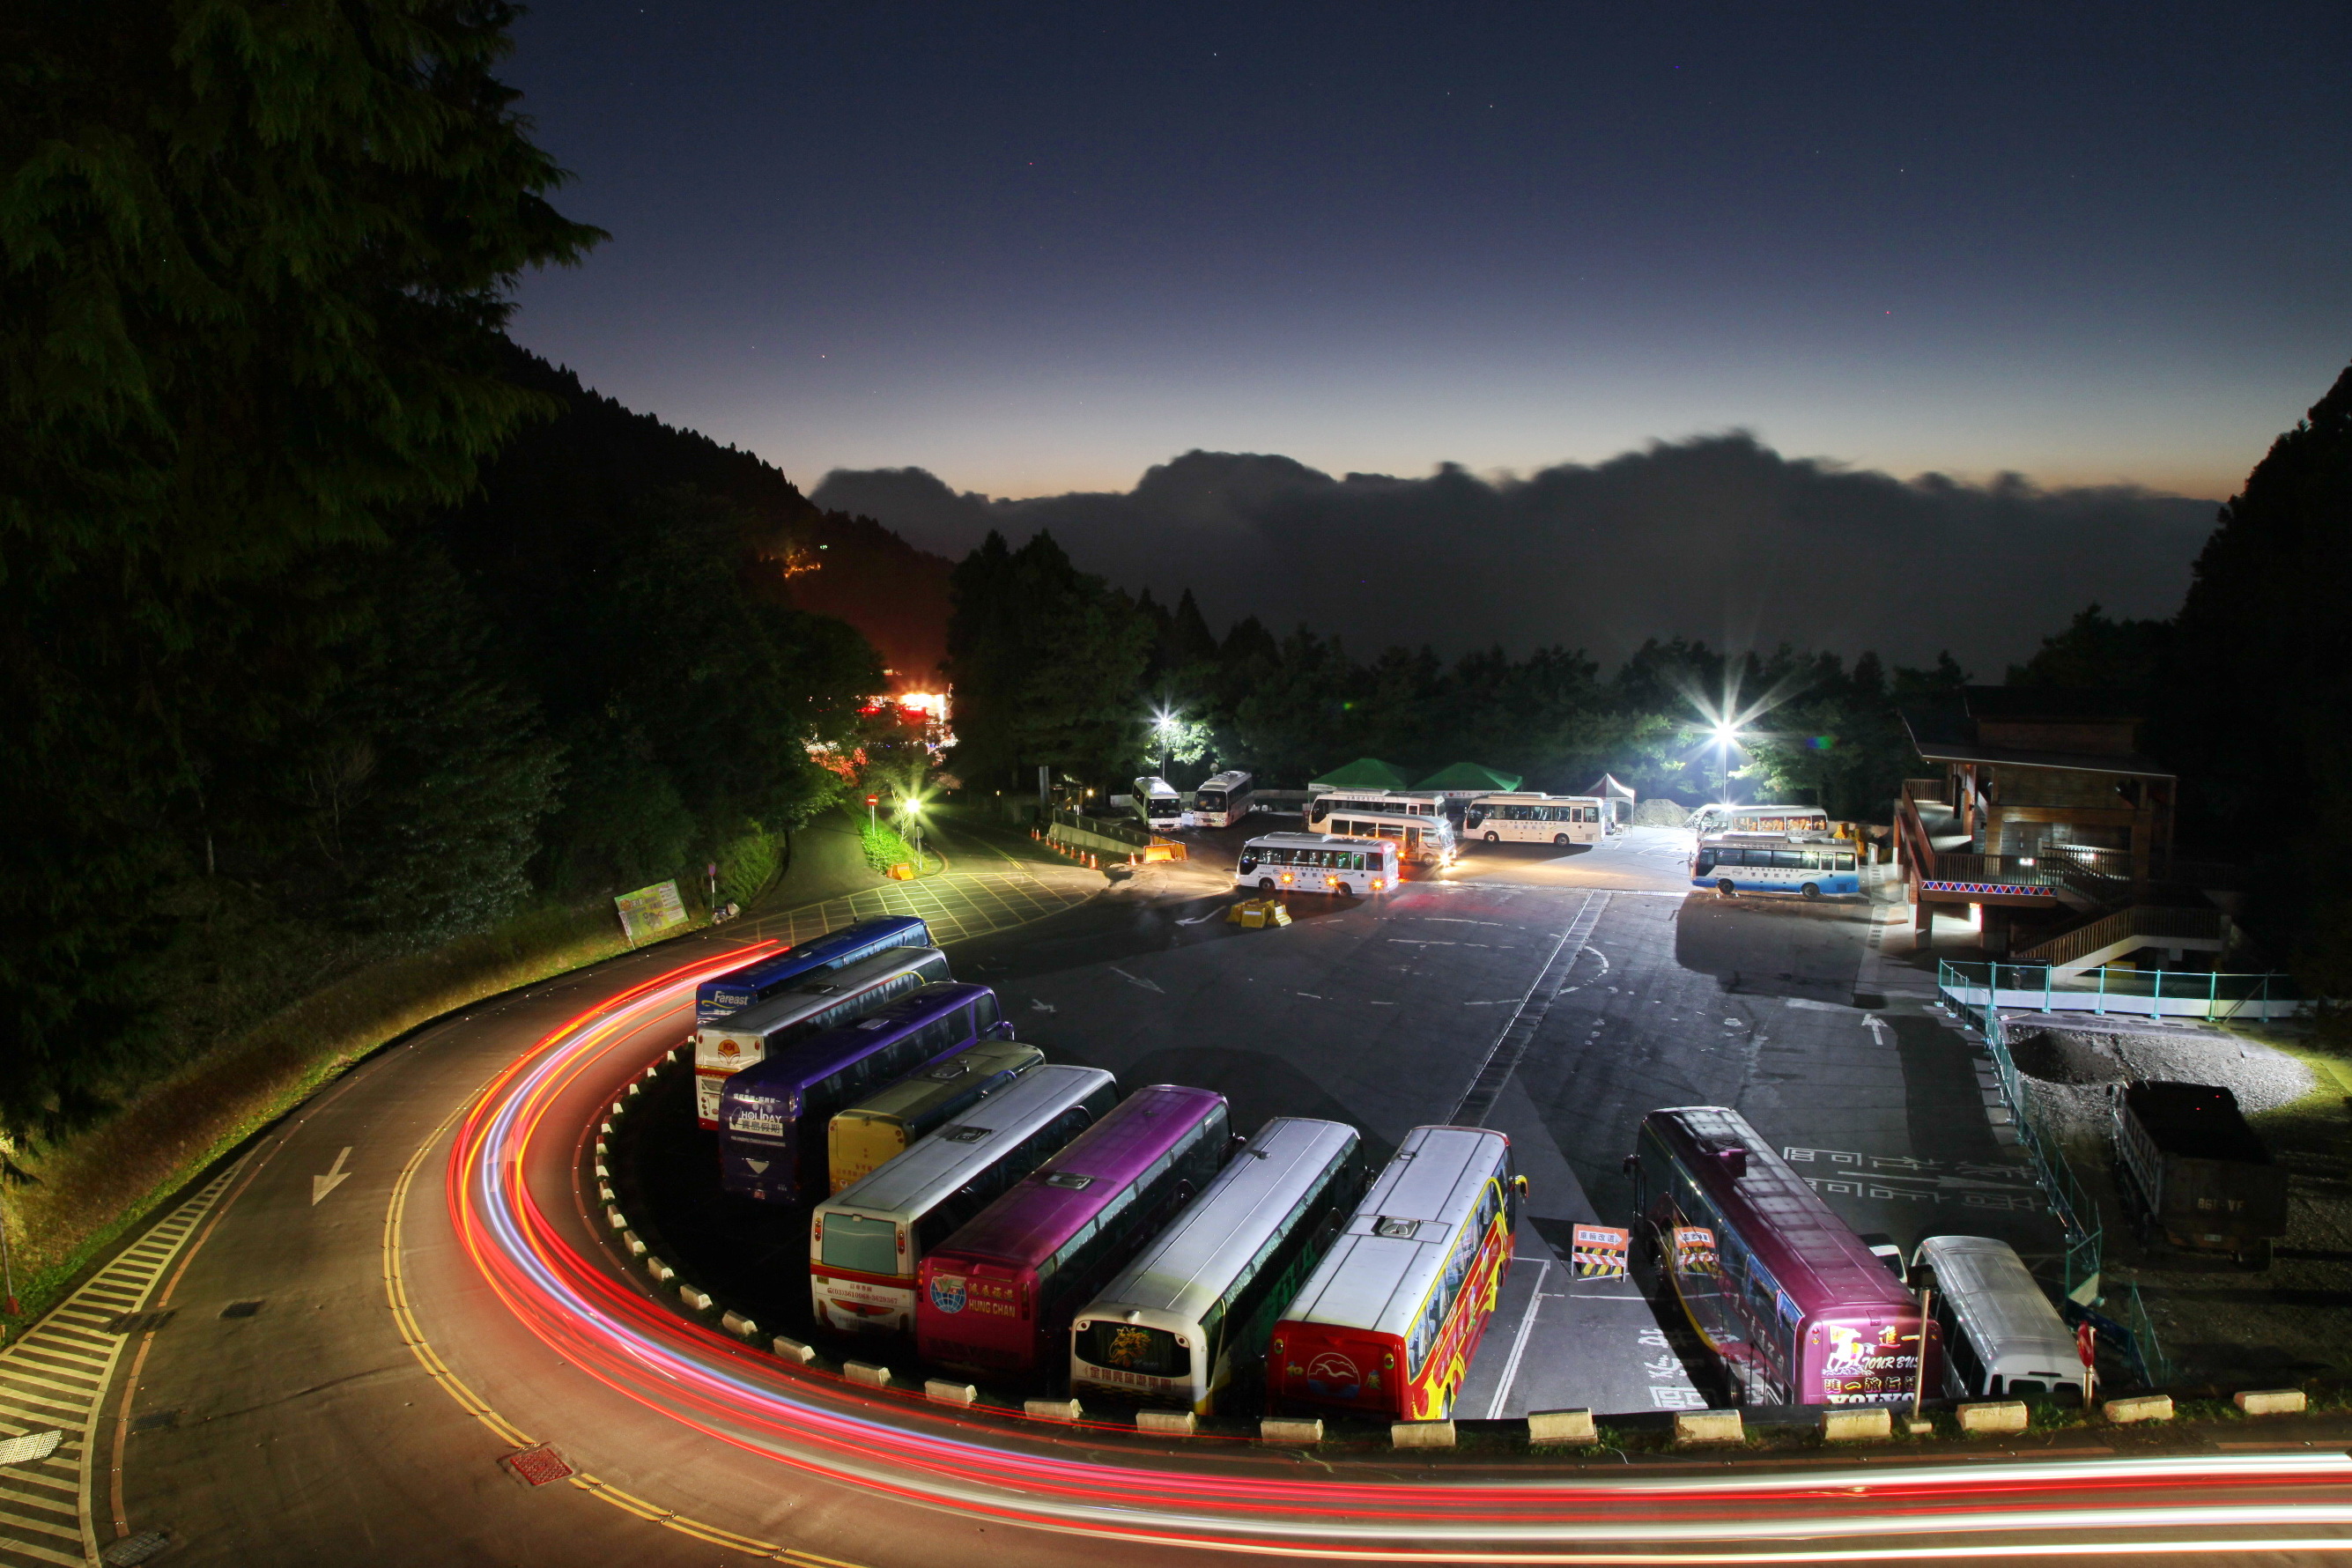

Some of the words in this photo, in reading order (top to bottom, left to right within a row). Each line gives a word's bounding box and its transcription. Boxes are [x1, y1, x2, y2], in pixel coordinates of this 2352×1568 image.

[714, 990, 750, 1006] Fareast
[741, 1106, 782, 1123] HOLIDAY
[741, 1119, 780, 1135] 寶島假期
[1579, 1231, 1616, 1243] 車輛改道
[968, 1298, 991, 1313] HUNG
[993, 1303, 1016, 1318] CHAN
[1878, 1325, 1921, 1350] 進一
[1286, 1360, 1305, 1379] 和
[1861, 1357, 1896, 1370] TOUR
[1823, 1376, 1916, 1394] 進一旅行社
